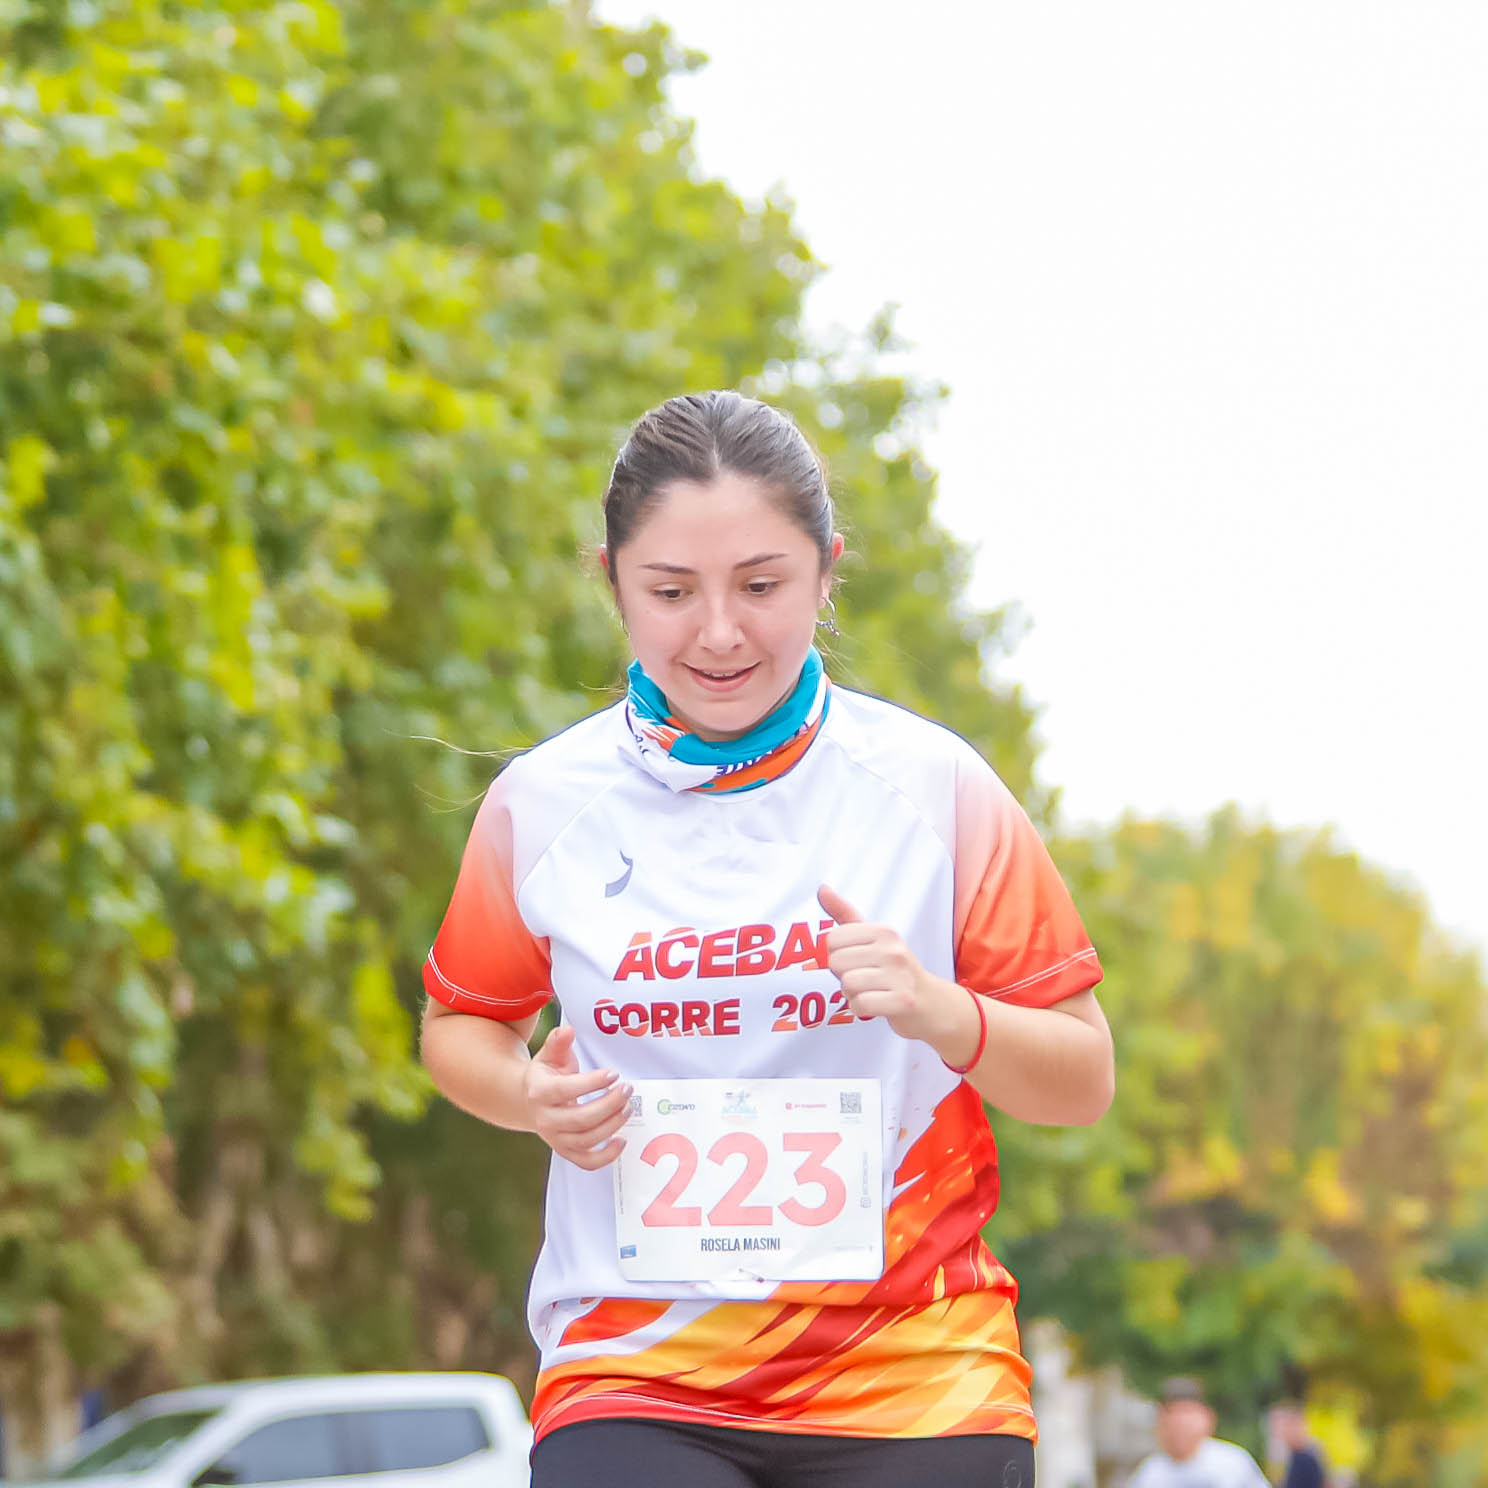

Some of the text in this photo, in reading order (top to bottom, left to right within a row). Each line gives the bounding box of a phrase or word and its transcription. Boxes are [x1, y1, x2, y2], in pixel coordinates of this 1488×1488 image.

[593, 990, 878, 1037] CORRE 202
[639, 1131, 847, 1227] 223
[700, 1237, 781, 1252] ROSELA MASINI
